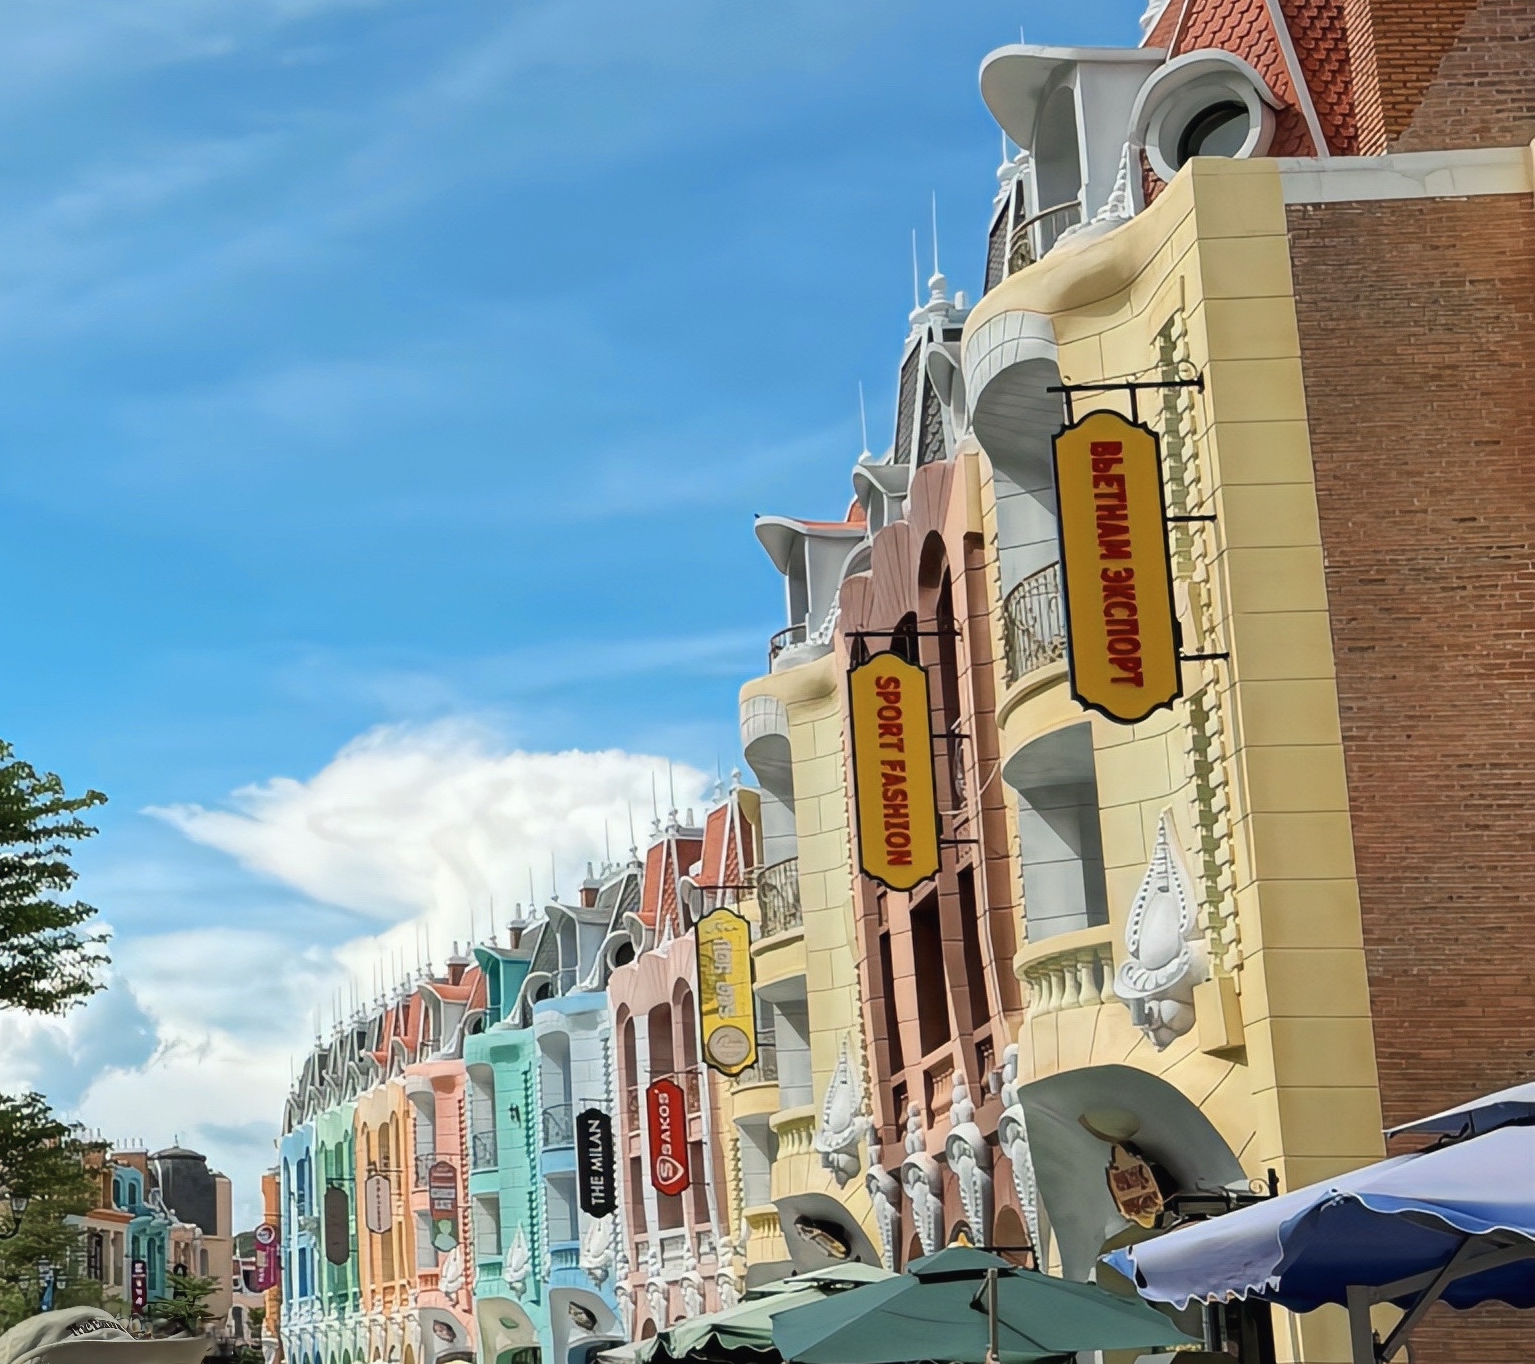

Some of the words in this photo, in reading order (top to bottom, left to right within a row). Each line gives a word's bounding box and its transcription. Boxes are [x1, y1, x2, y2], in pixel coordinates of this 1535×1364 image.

[1089, 440, 1133, 561] ВЬЕТНАМ
[1100, 567, 1145, 688] ЭКСПОРТ
[874, 675, 905, 753] SPORT
[880, 759, 912, 866] FASHION
[588, 1119, 603, 1172] MILAN
[658, 1092, 672, 1155] SAKOS
[590, 1175, 606, 1205] THE
